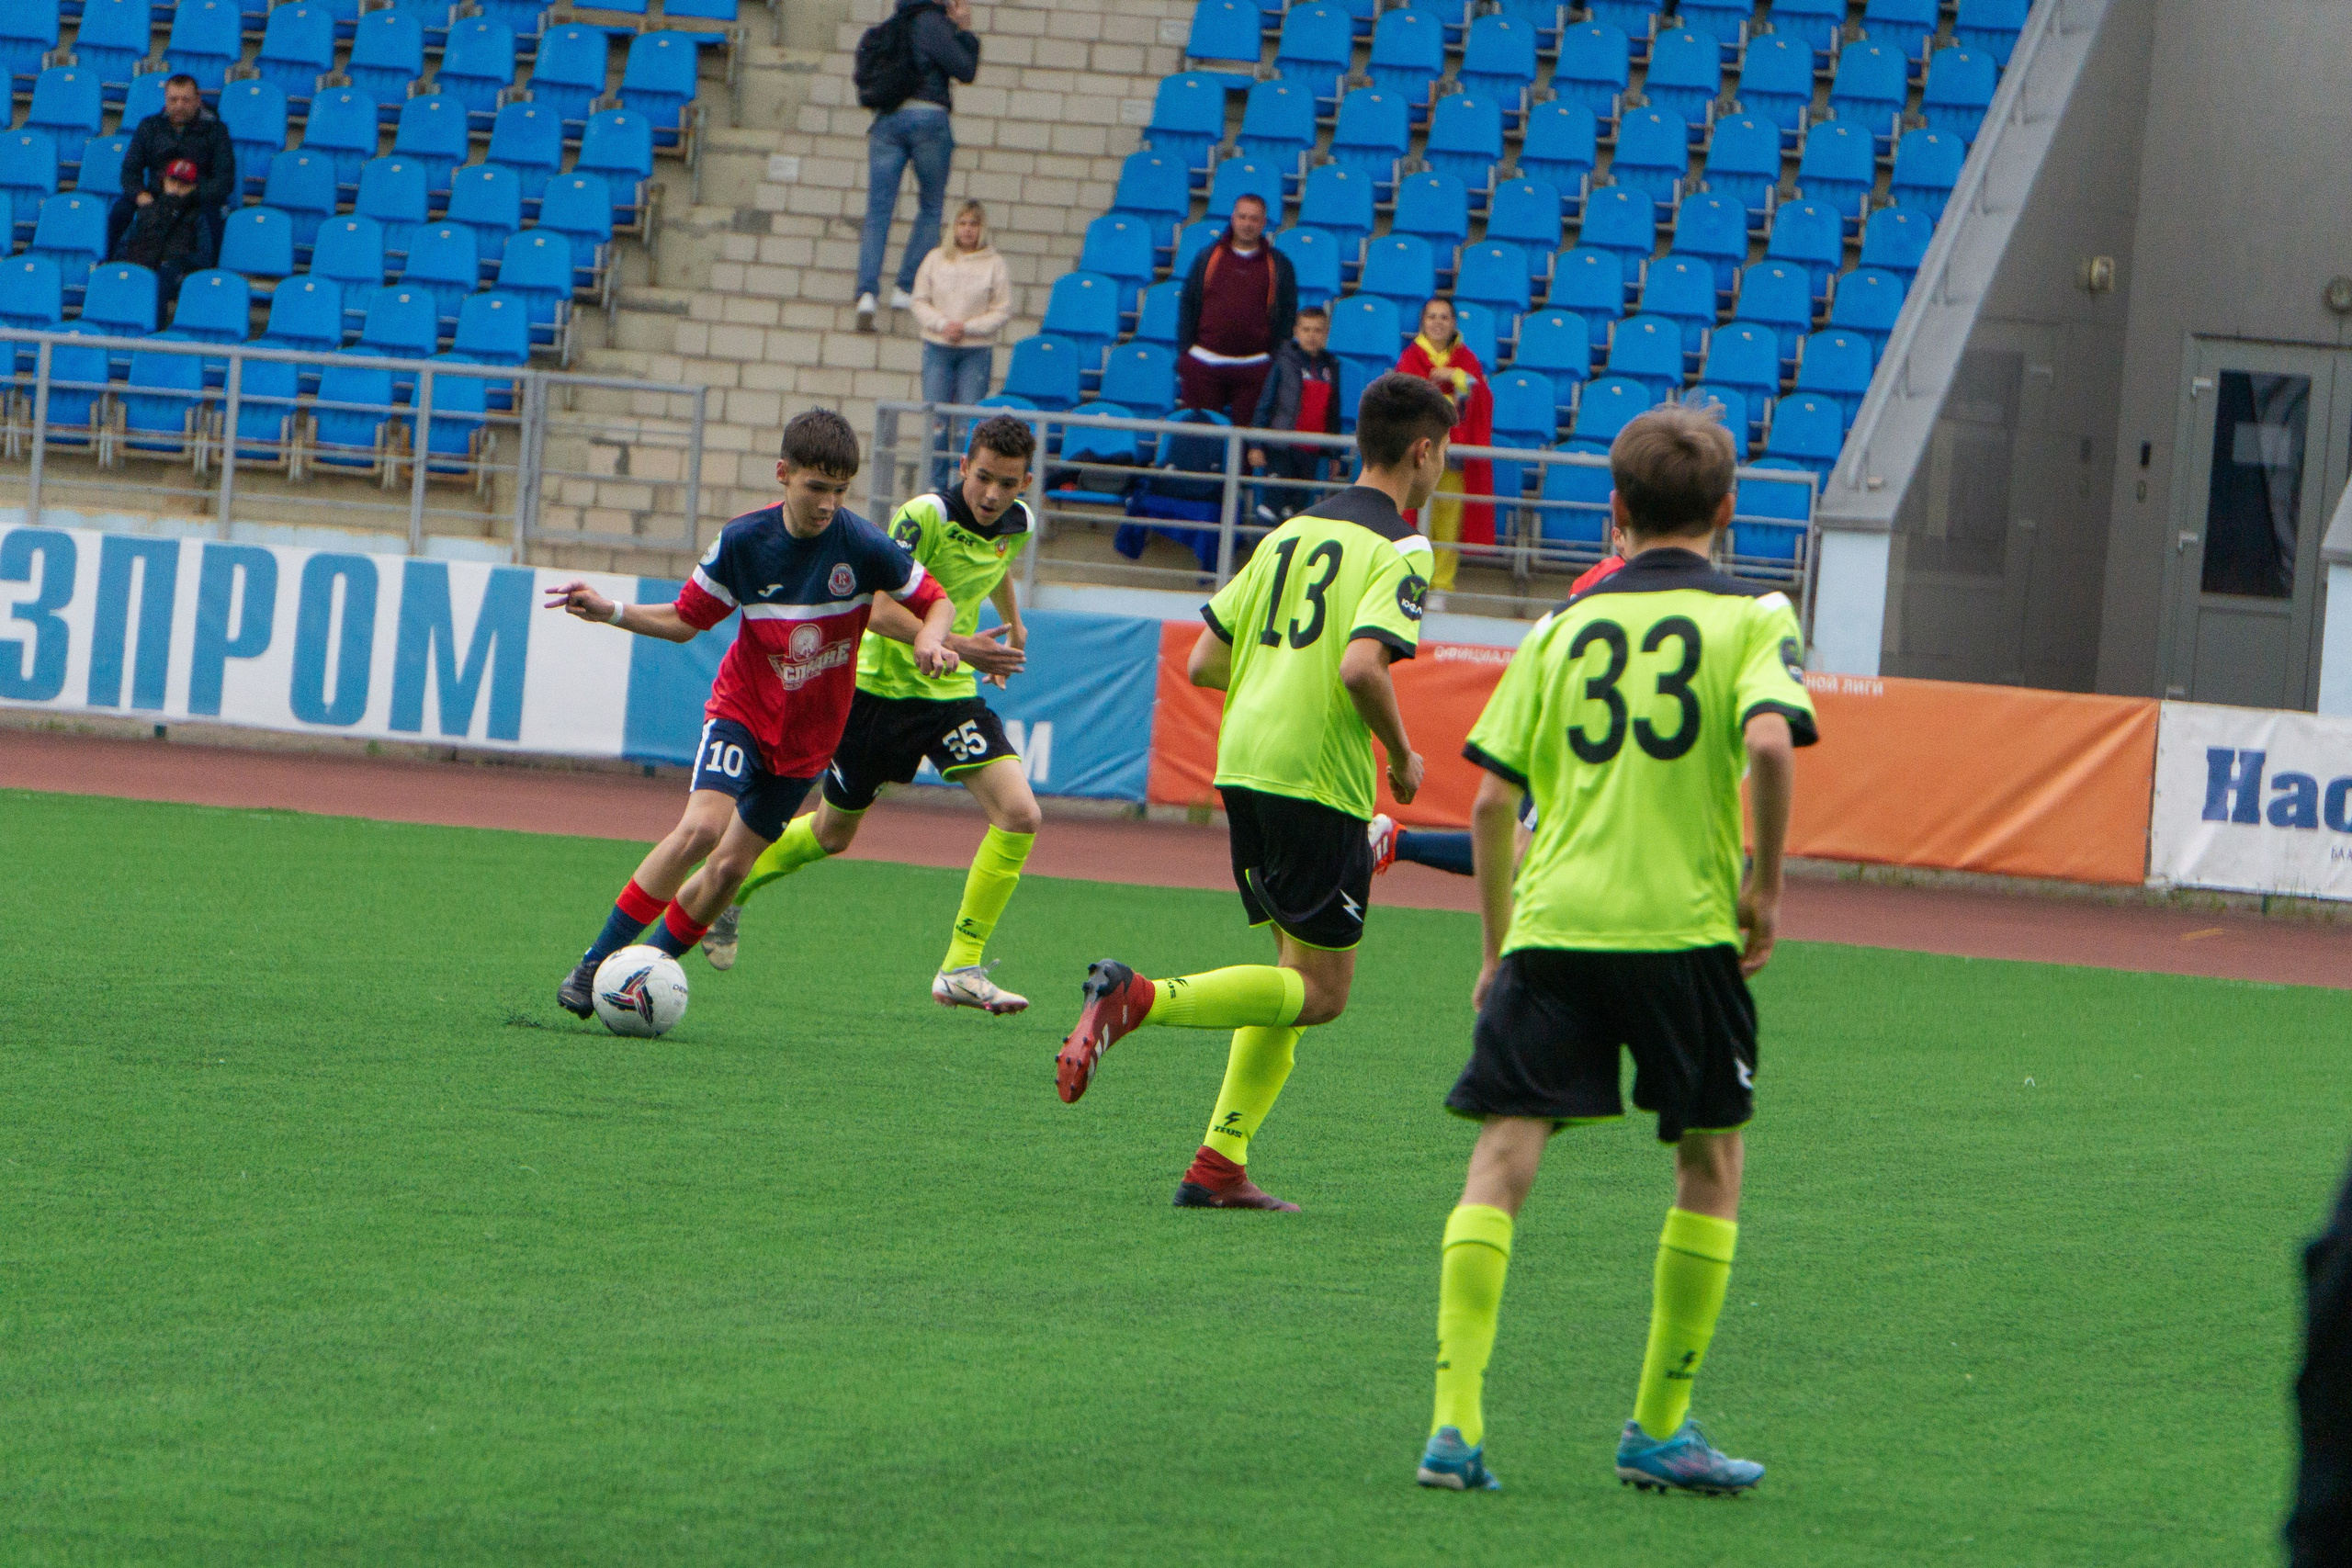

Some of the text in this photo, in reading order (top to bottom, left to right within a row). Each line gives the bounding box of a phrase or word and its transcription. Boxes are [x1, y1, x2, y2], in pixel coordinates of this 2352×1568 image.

[1260, 536, 1344, 649] 13
[1566, 615, 1702, 765] 33
[1843, 678, 1884, 696] ЛИГИ
[706, 739, 744, 778] 10
